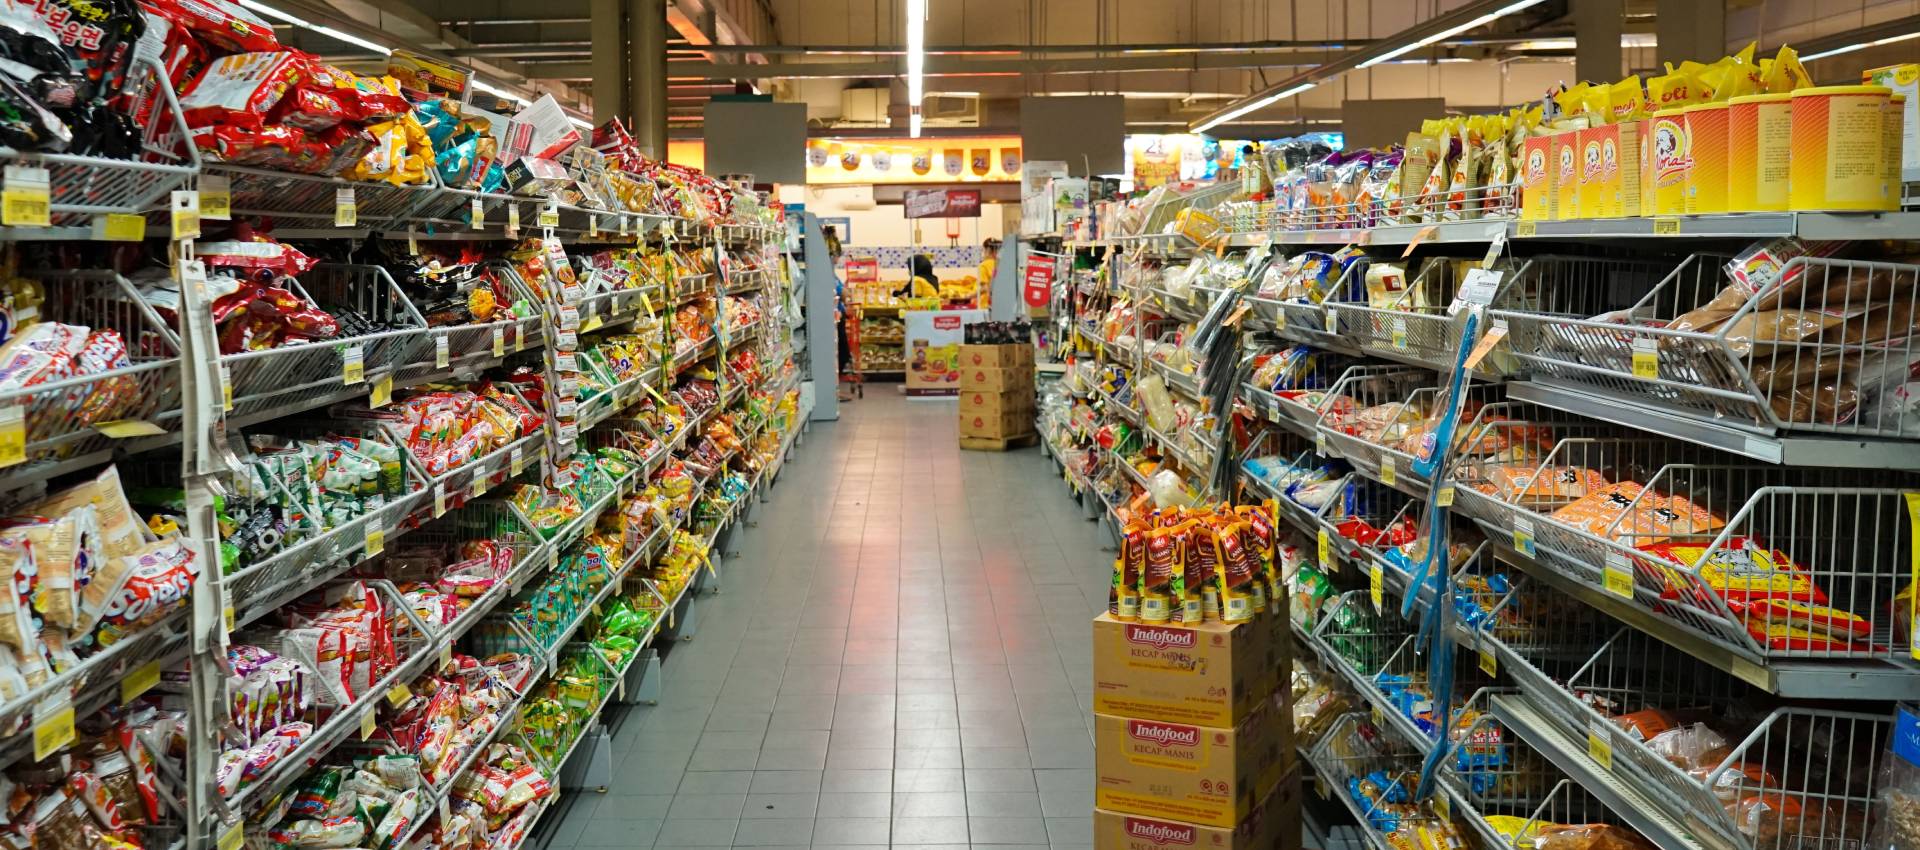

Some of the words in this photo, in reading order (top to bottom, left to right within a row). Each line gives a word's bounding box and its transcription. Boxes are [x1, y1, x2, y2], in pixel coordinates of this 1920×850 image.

[1133, 628, 1191, 646] Indofood
[1131, 648, 1159, 658] KECAP
[1136, 724, 1195, 743] Indofood
[1134, 744, 1161, 755] KECAP
[1164, 749, 1194, 759] MANIS
[1132, 822, 1191, 841] Indofood
